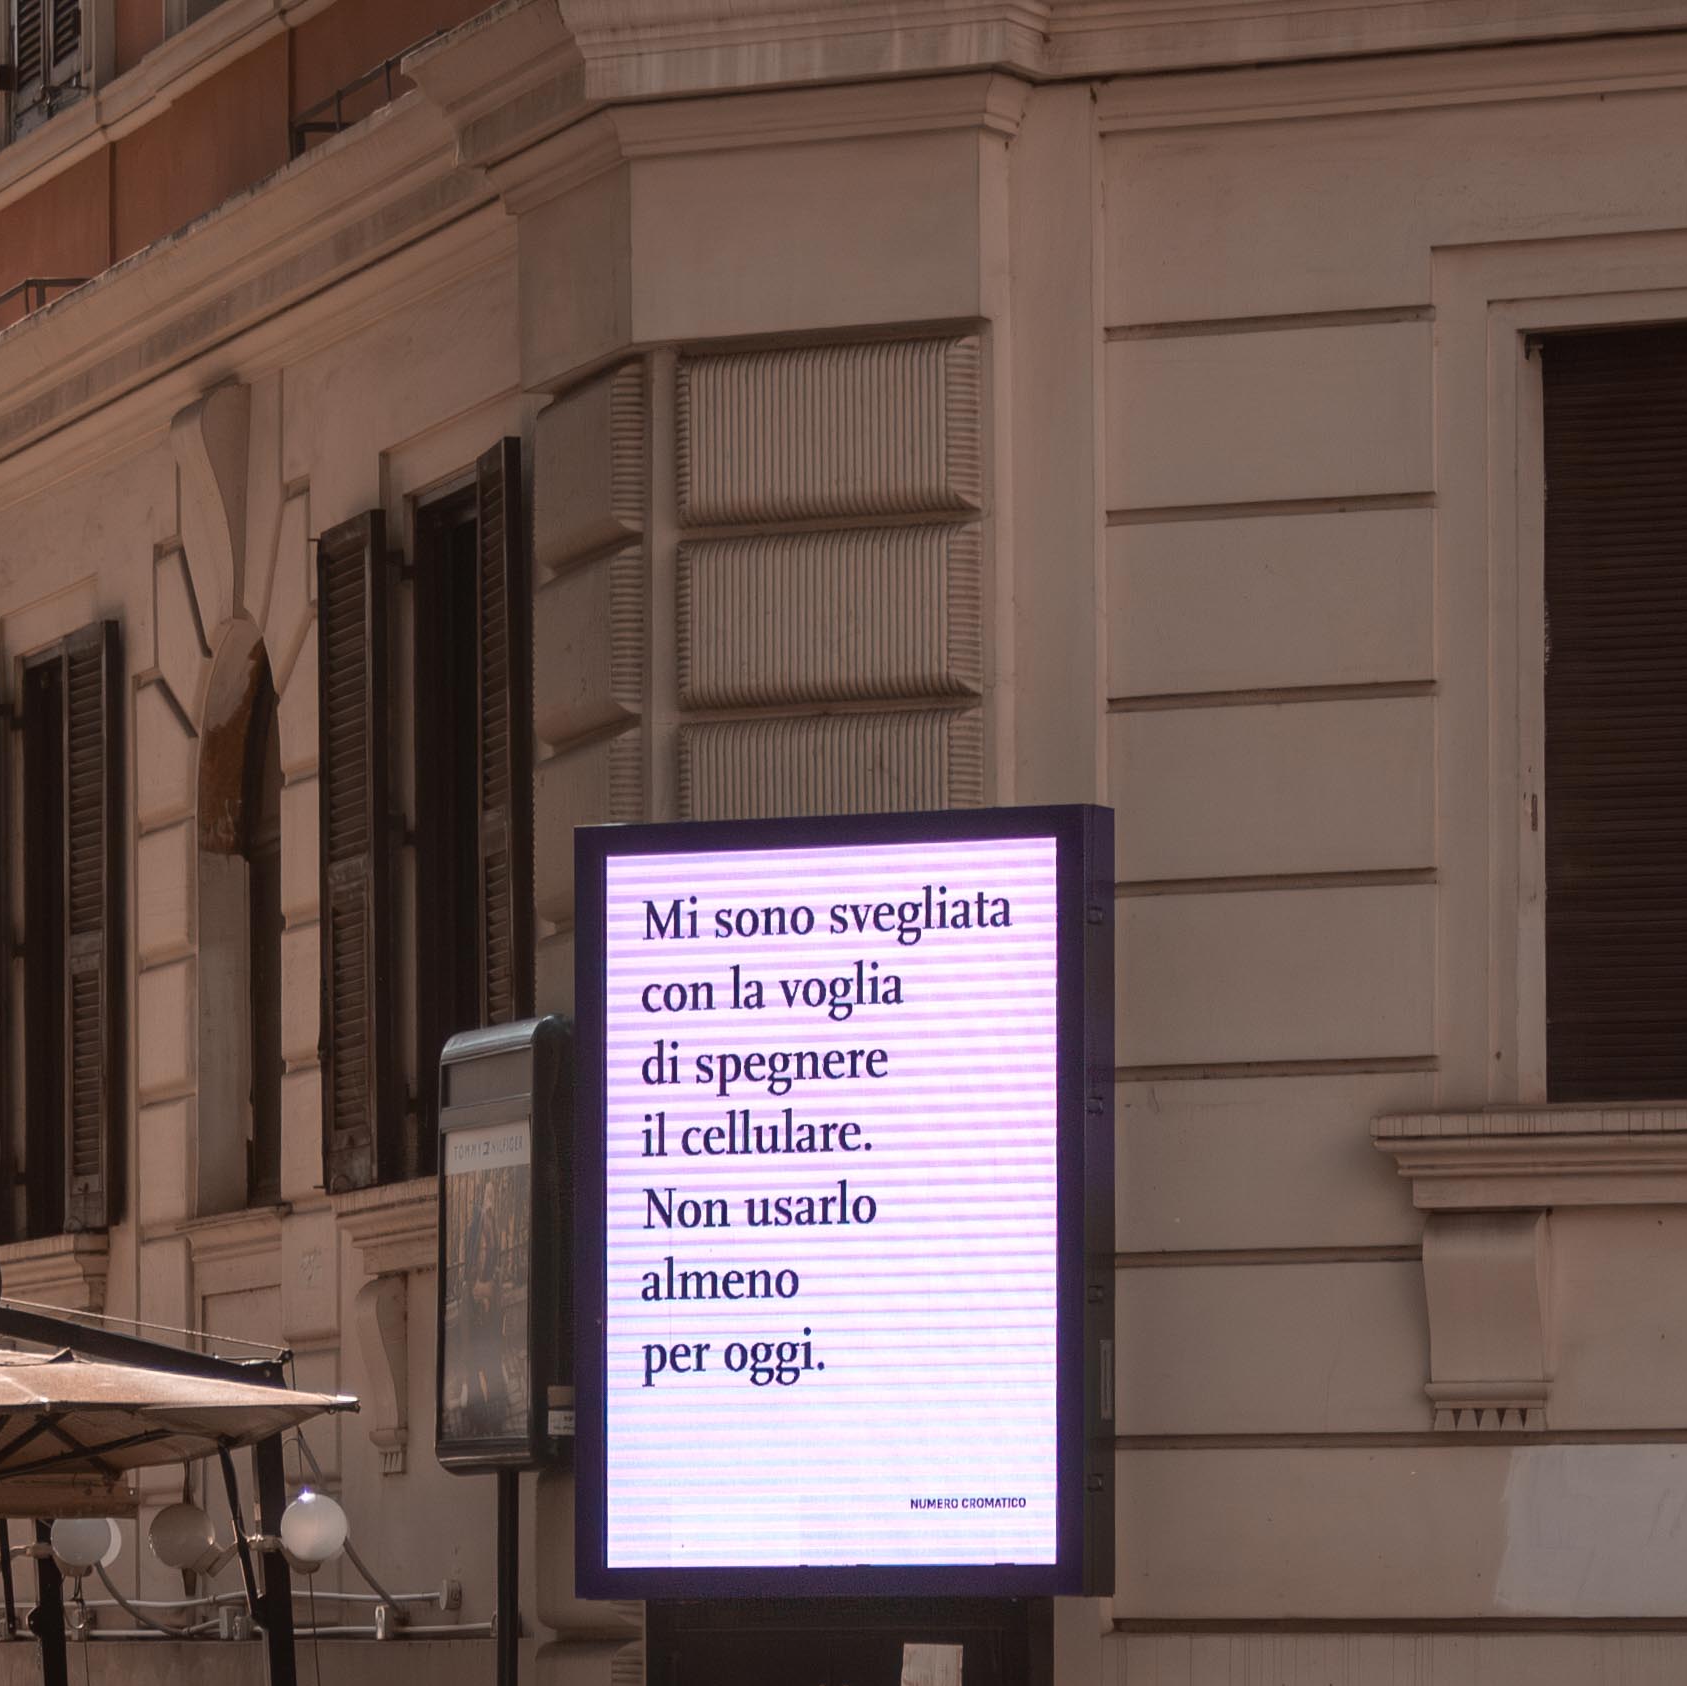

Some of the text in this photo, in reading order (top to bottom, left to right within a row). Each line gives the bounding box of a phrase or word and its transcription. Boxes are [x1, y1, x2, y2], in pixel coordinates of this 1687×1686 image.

[642, 886, 1011, 945] Mi sono svegliata
[641, 962, 904, 1021] con la voglia
[642, 1041, 888, 1096] di spegnere
[641, 1110, 872, 1157] il cellulare.
[642, 1180, 877, 1230] Non usarlo
[641, 1256, 799, 1302] almeno
[642, 1327, 825, 1386] per oggi.
[910, 1495, 1026, 1510] NUMERO CROMATICO
